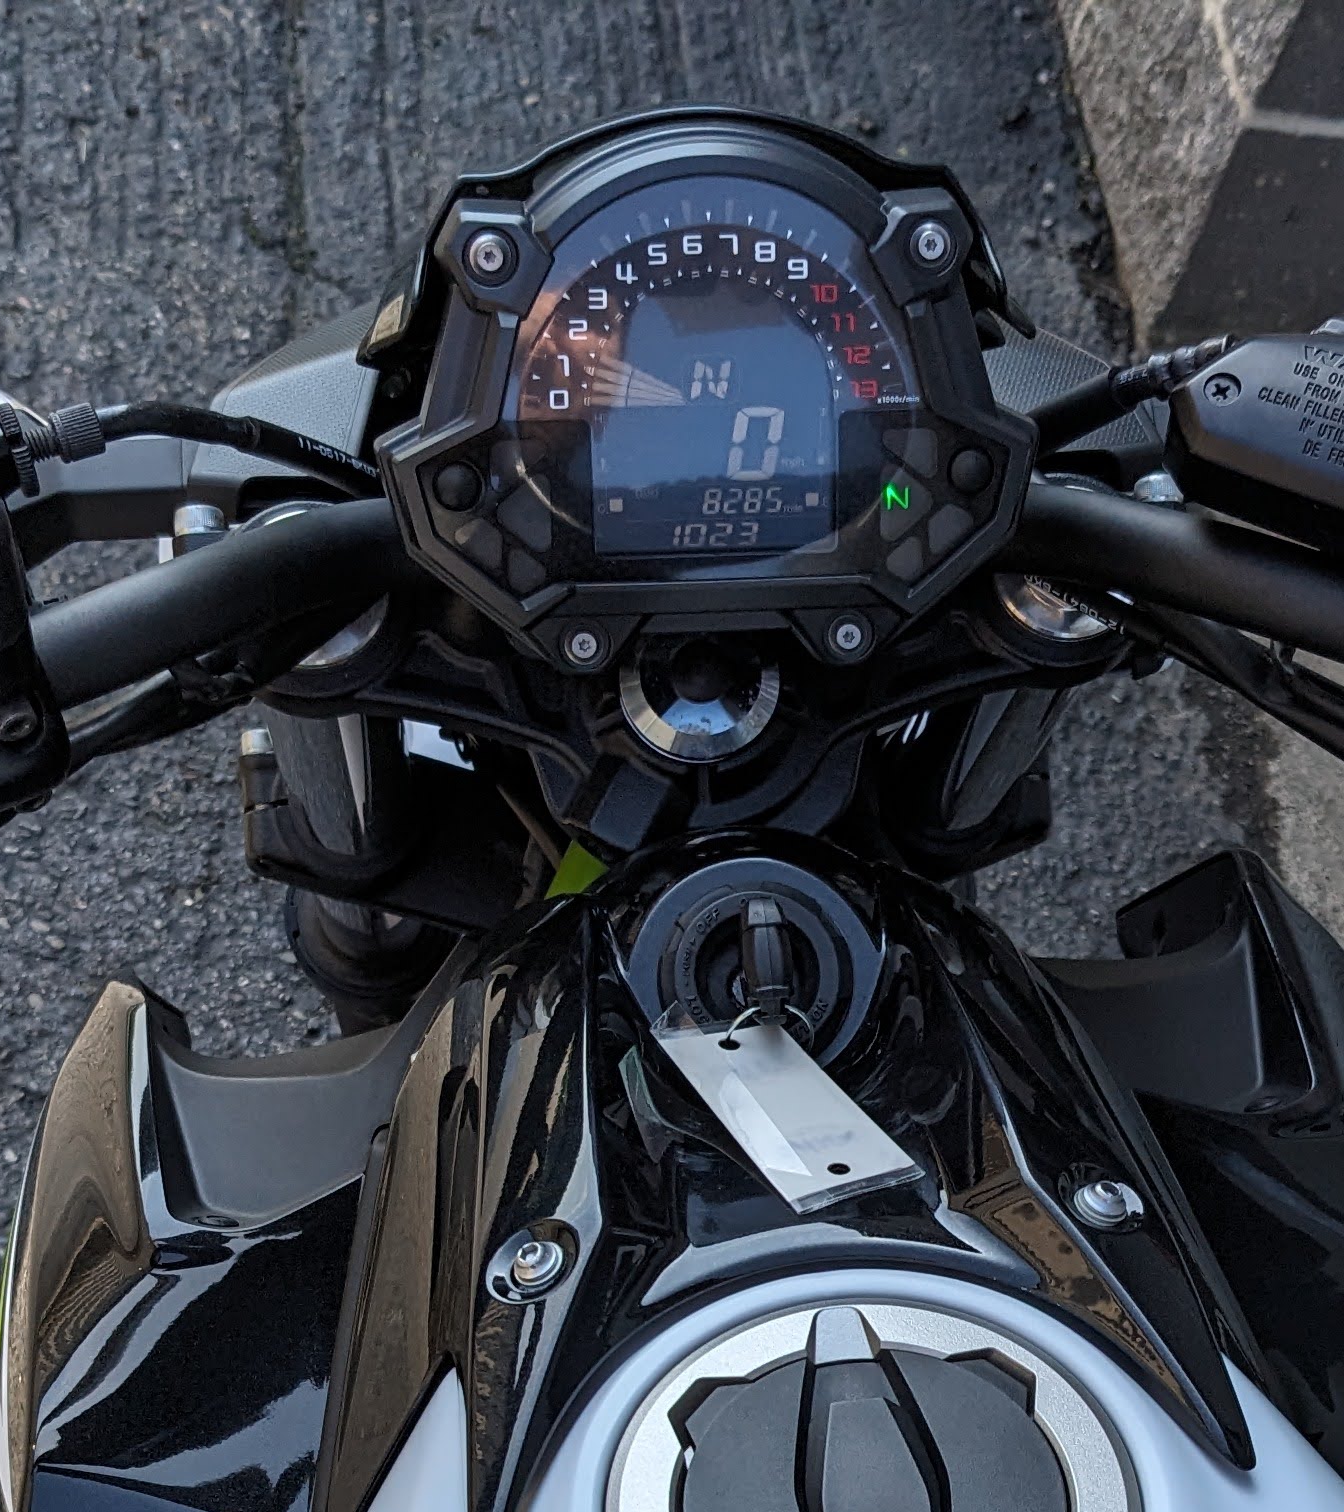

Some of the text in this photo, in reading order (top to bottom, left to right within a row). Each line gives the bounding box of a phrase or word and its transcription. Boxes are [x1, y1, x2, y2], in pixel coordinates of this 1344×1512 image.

[550, 234, 878, 409] 0 1 2 3 4 5 6 7 8 9 10 11 12 13
[691, 361, 731, 399] N
[1293, 362, 1320, 380] USE
[1258, 387, 1301, 411] CLEAN
[1304, 381, 1341, 403] FROM
[727, 406, 784, 481] 0
[1302, 438, 1323, 458] DE
[703, 487, 783, 515] 8285
[886, 484, 909, 510] N
[672, 521, 759, 547] 1023
[696, 907, 720, 935] OFF
